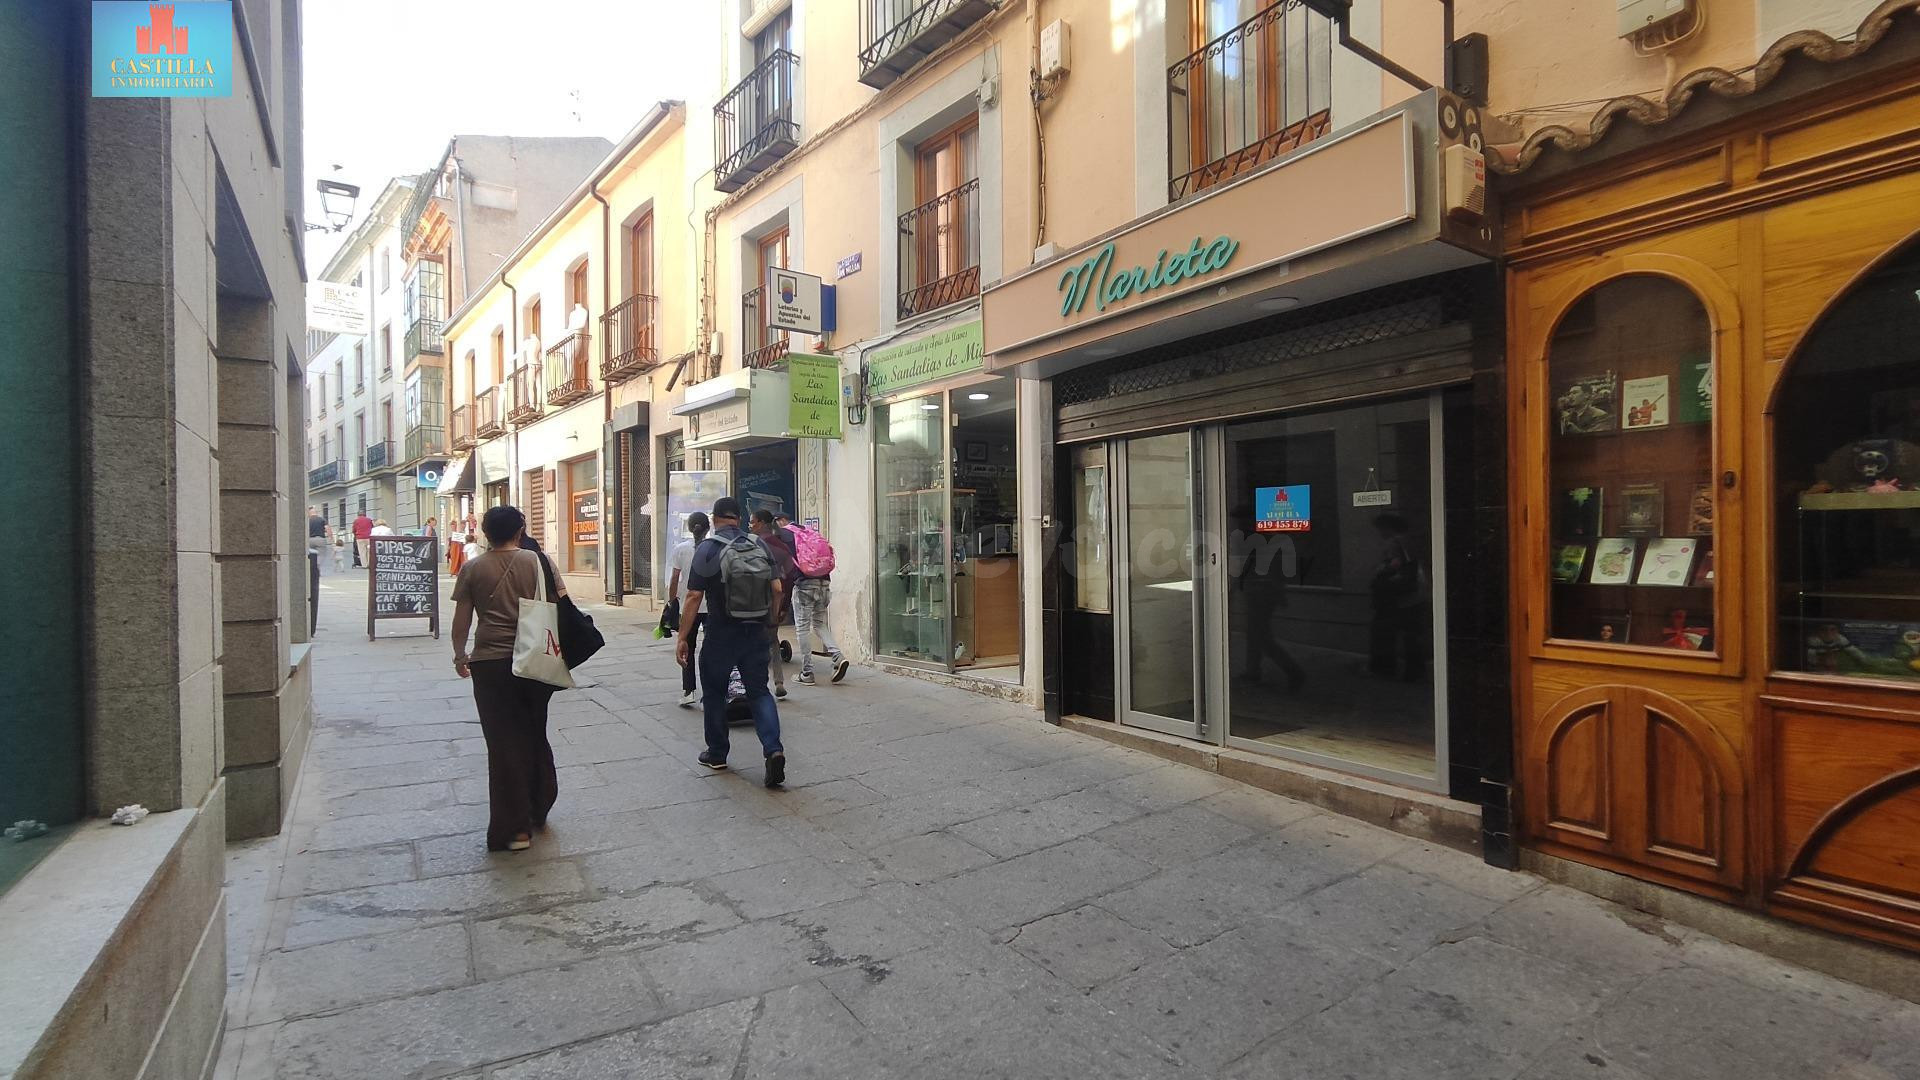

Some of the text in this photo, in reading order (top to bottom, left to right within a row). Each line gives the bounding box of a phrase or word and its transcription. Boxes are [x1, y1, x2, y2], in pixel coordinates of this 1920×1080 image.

[1058, 235, 1240, 317] Marieta
[868, 370, 888, 388] Las
[890, 355, 942, 382] Sandalias
[945, 348, 958, 368] de
[806, 378, 824, 390] Las
[791, 392, 838, 407] Sandalias
[810, 410, 820, 421] de
[799, 425, 833, 437] Miguel
[1257, 520, 1309, 529] 619 455 879
[375, 541, 414, 554] PIPAS
[376, 555, 422, 564] TOSTADAS
[376, 573, 422, 582] GRANIZADO
[376, 583, 417, 592] HELADOS
[405, 594, 427, 602] PARA
